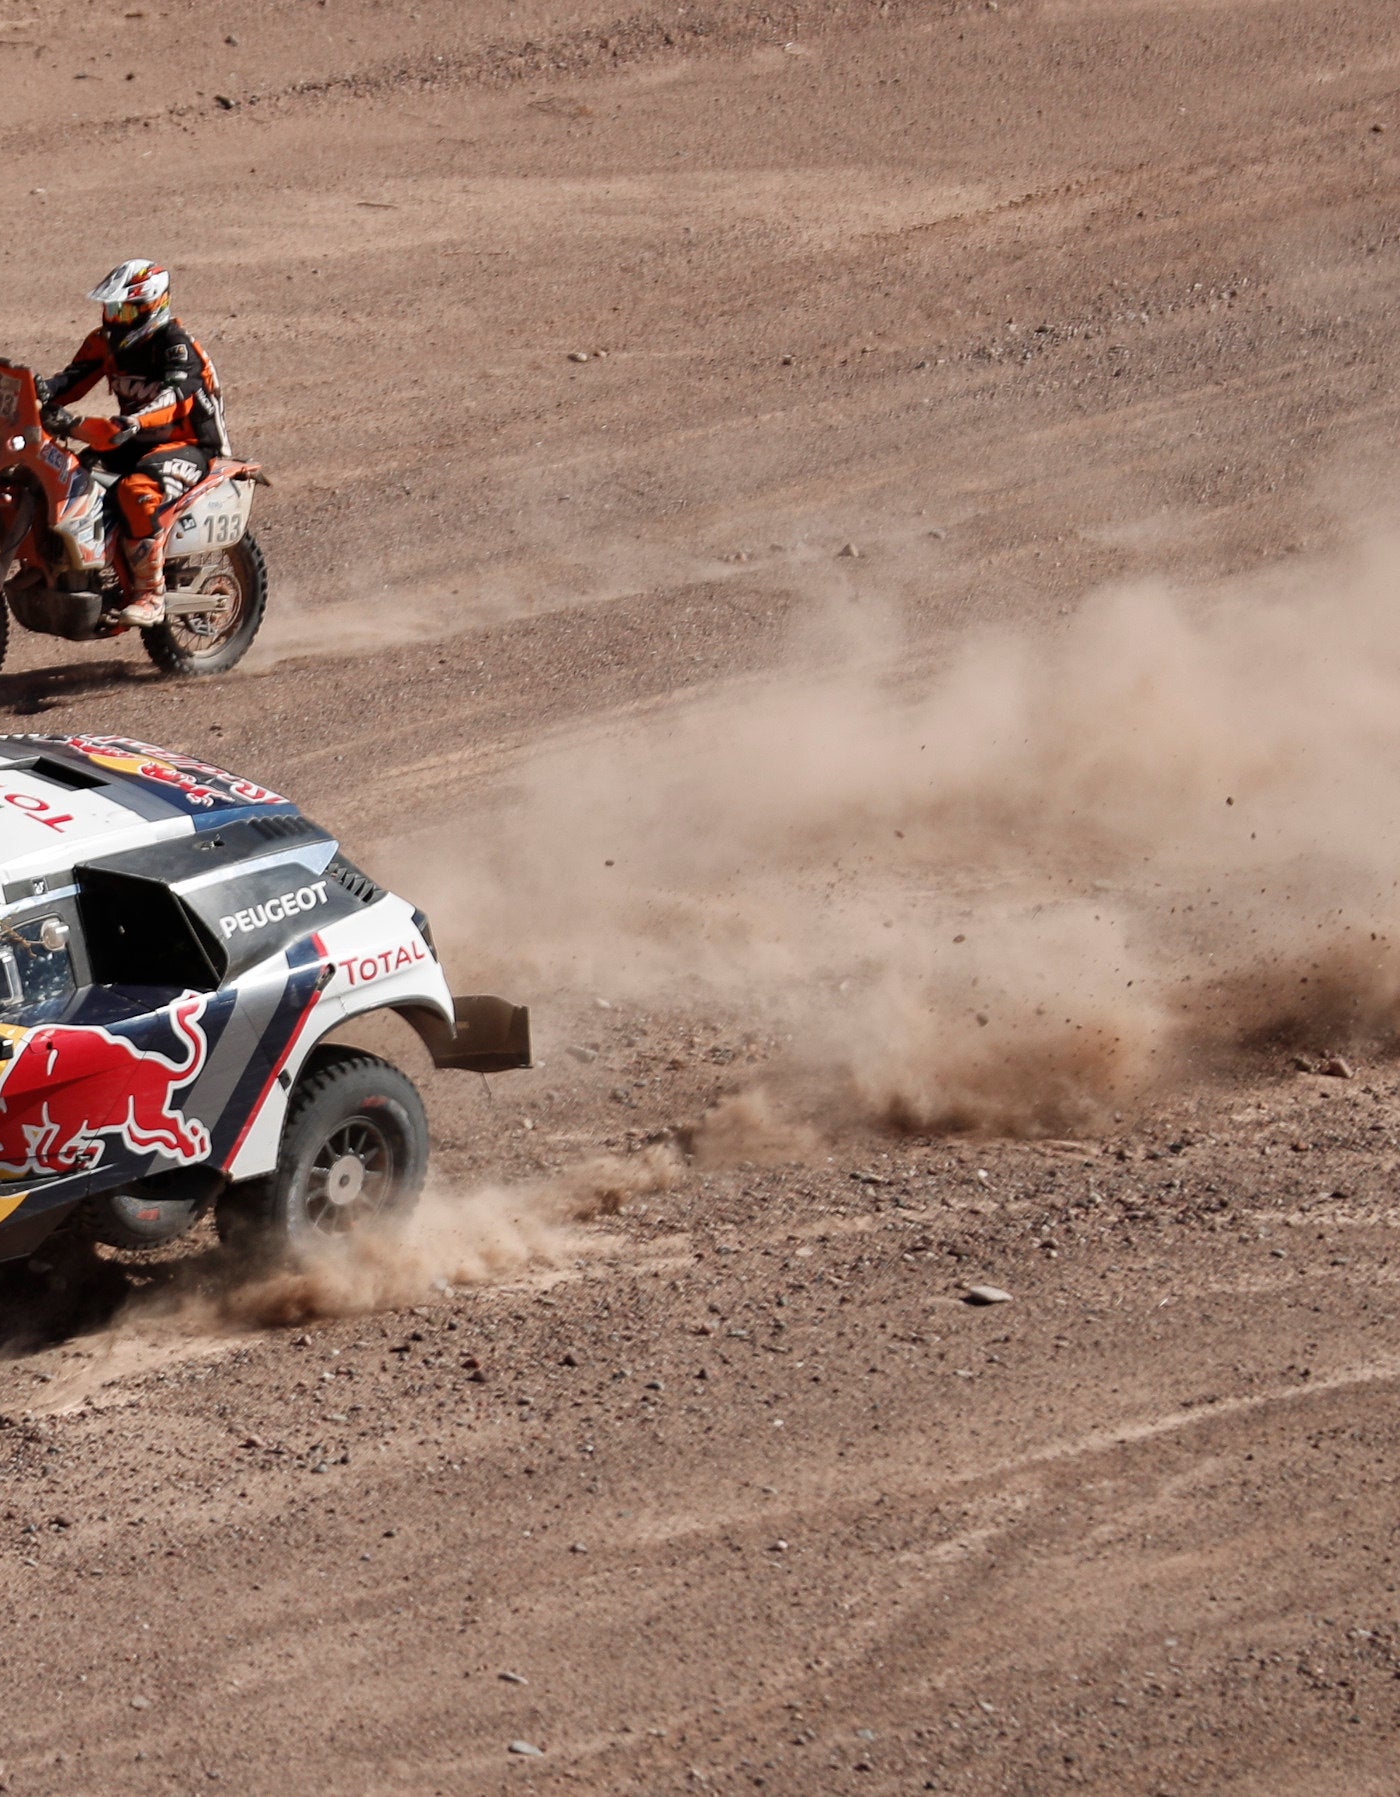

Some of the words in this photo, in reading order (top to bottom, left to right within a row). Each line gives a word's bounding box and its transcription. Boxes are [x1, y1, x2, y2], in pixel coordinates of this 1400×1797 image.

[161, 458, 202, 487] KTM
[204, 514, 242, 543] 133
[219, 880, 328, 940] PEUGEOT
[339, 941, 426, 985] TOTAL
